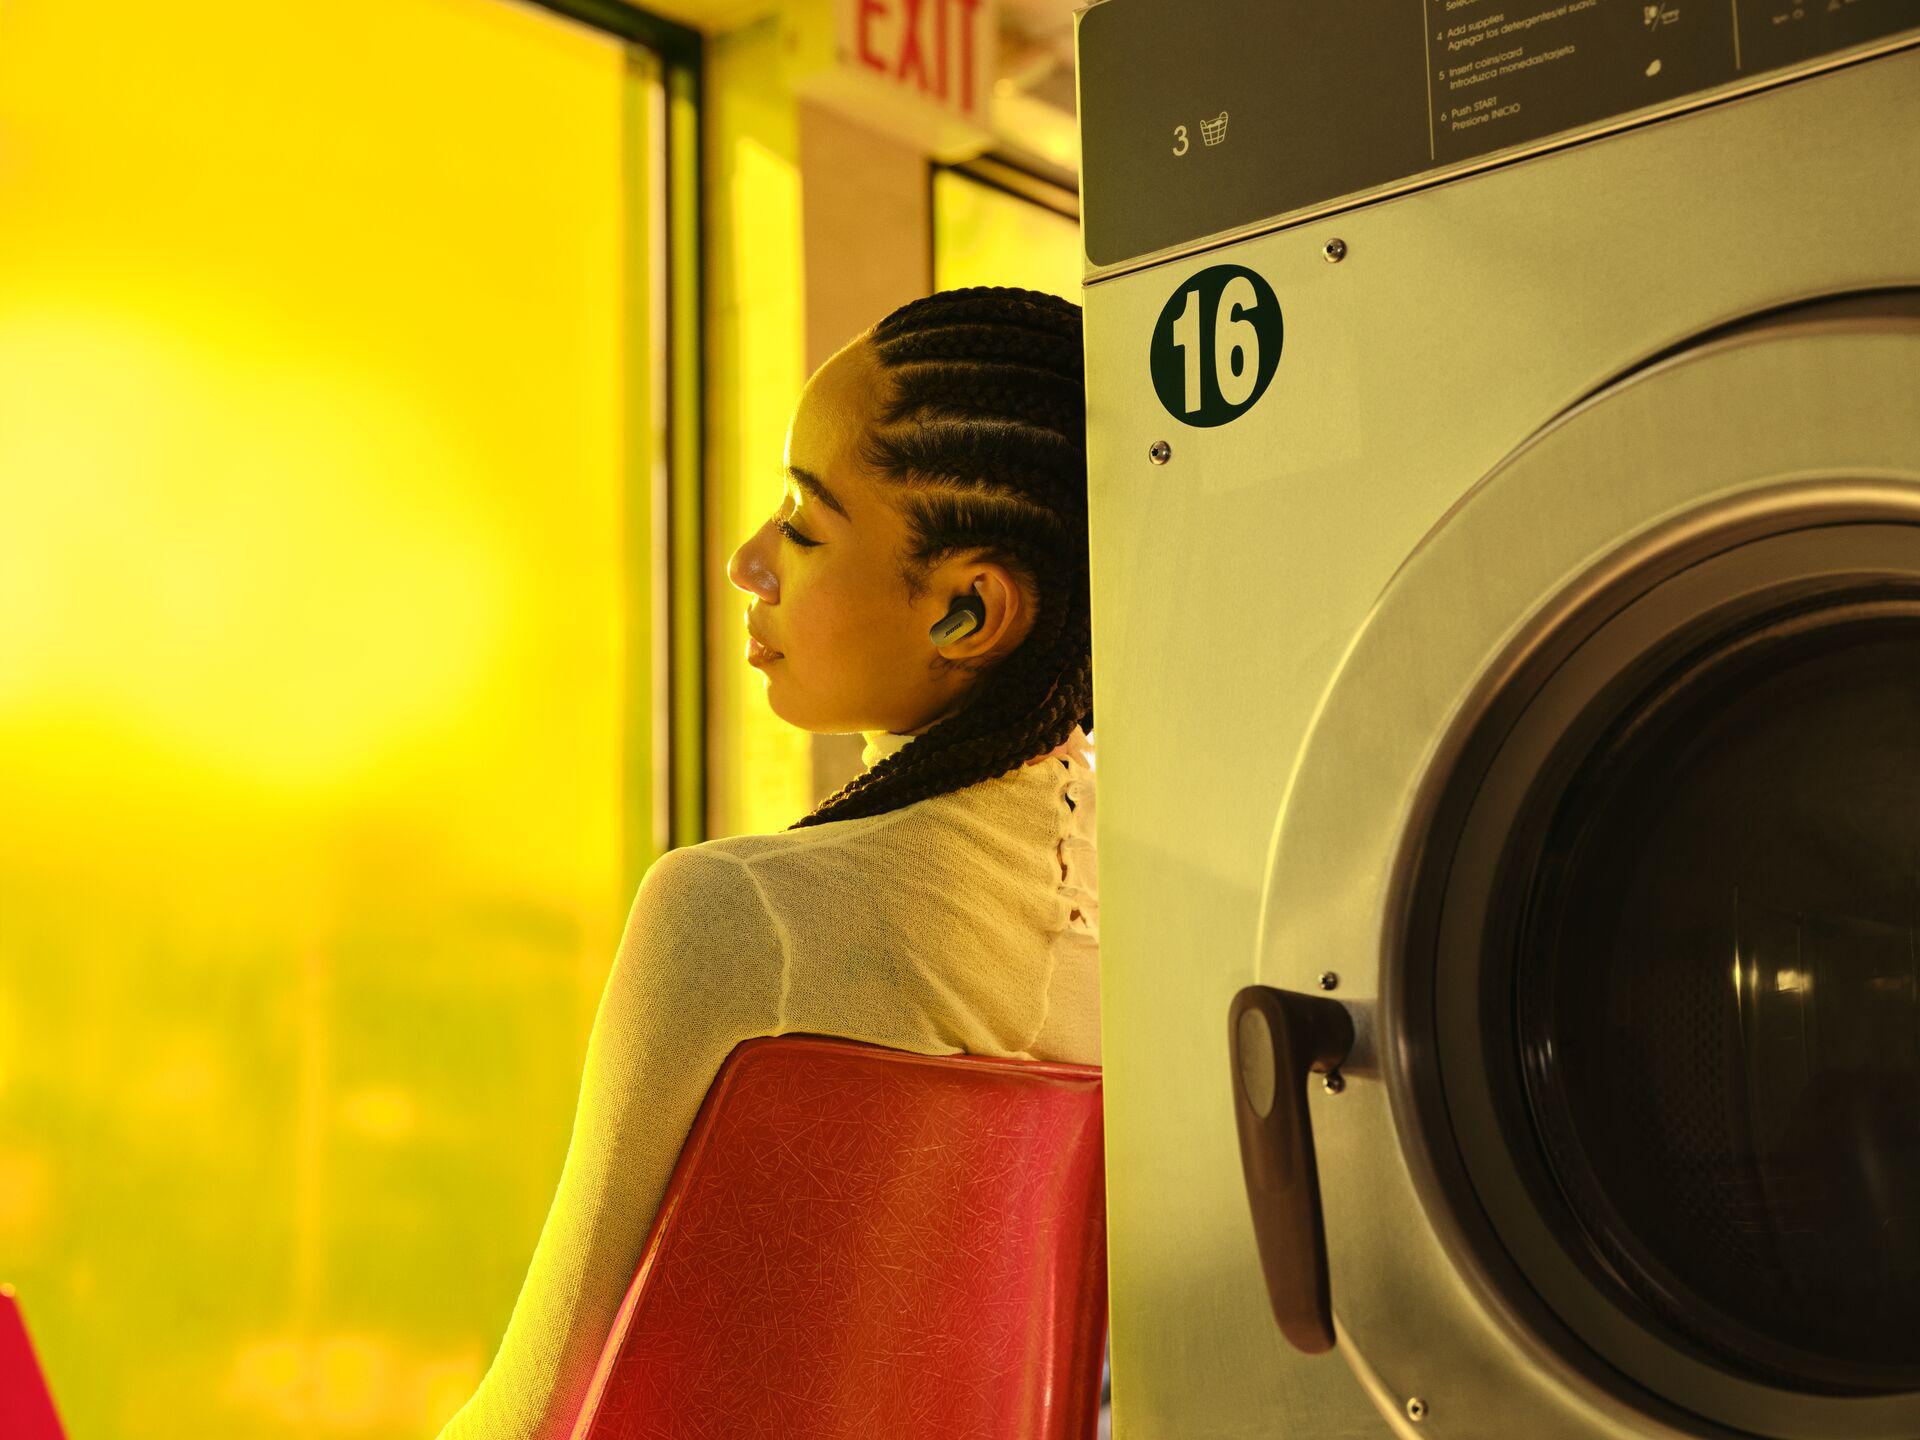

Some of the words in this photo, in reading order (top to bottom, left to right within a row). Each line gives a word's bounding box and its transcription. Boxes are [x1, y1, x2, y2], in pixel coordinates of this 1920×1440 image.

[1436, 32, 1443, 41] 4
[1447, 24, 1467, 38] Add
[1468, 13, 1505, 31] supplies
[1447, 33, 1485, 52] Agregar
[1486, 29, 1499, 39] los
[857, 0, 982, 112] EXIT
[1439, 71, 1446, 81] 5
[1449, 61, 1473, 77] Insert
[1474, 47, 1524, 70] coins/card
[1450, 68, 1498, 90] Introduzca
[1499, 45, 1576, 75] monedas/tarjeta
[1440, 113, 1447, 122] 6
[1451, 105, 1472, 118] Push
[1473, 96, 1498, 112] START
[1452, 113, 1490, 132] Presione
[1491, 103, 1521, 120] INICIO
[1173, 125, 1189, 157] 3
[1173, 276, 1259, 414] 16
